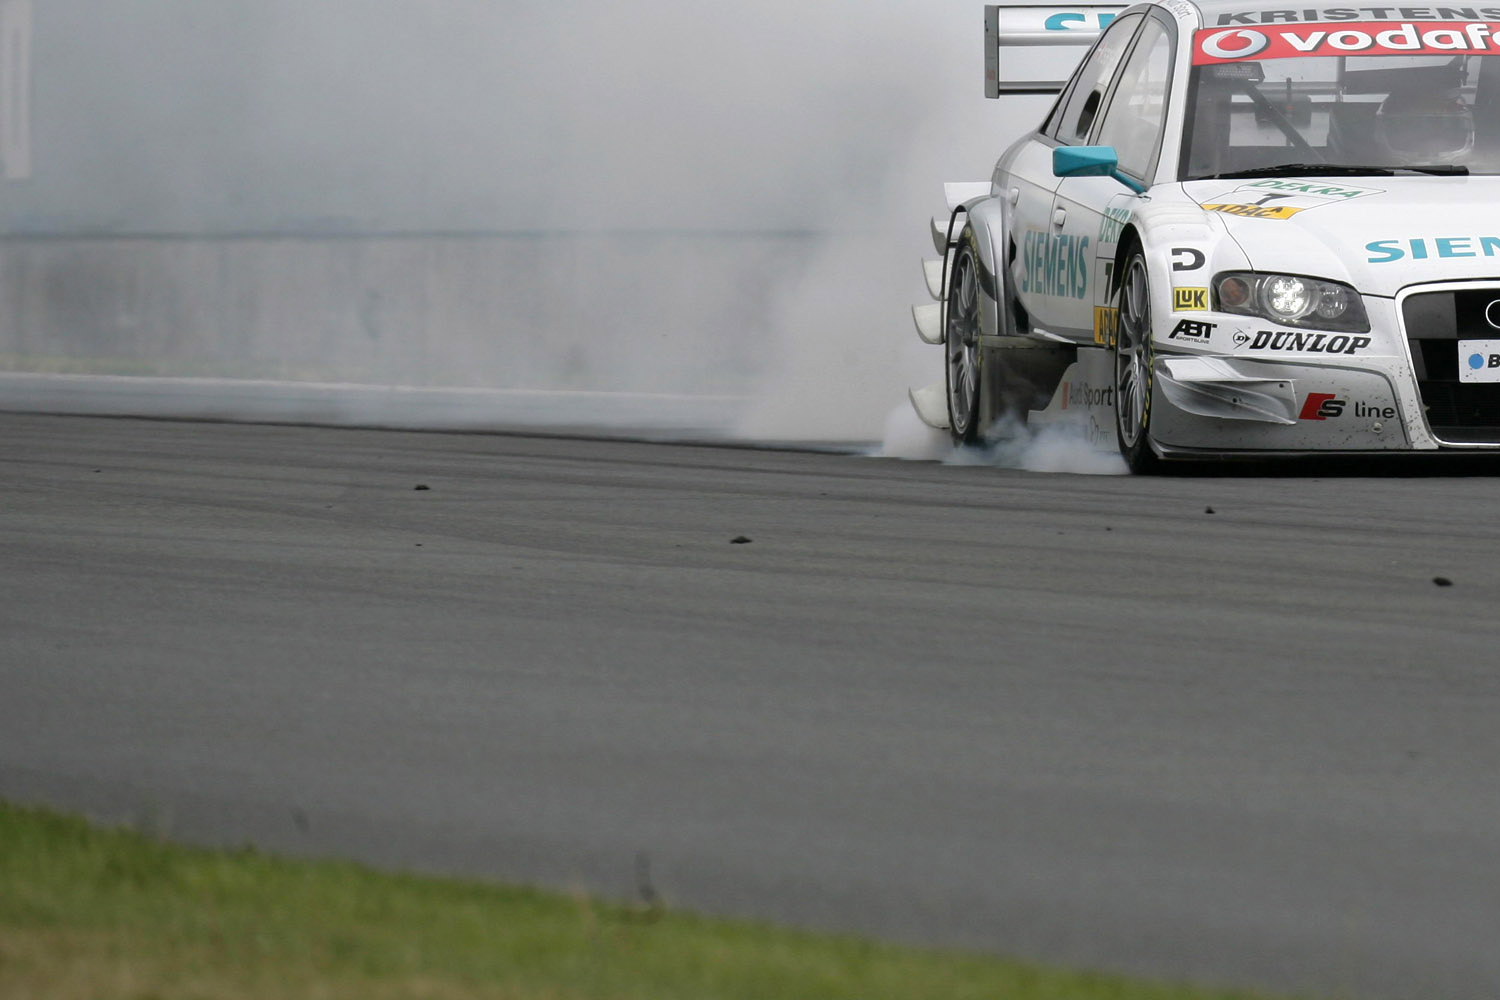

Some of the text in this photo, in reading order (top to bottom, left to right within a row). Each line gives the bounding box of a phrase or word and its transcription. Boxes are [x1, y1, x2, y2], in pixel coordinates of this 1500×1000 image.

[1249, 180, 1363, 198] DEKRA
[1022, 230, 1090, 299] SIEMENS
[1168, 319, 1218, 339] ABT
[1249, 330, 1372, 354] DUNLOP
[1084, 382, 1113, 410] Sport
[1316, 400, 1395, 419] S line
